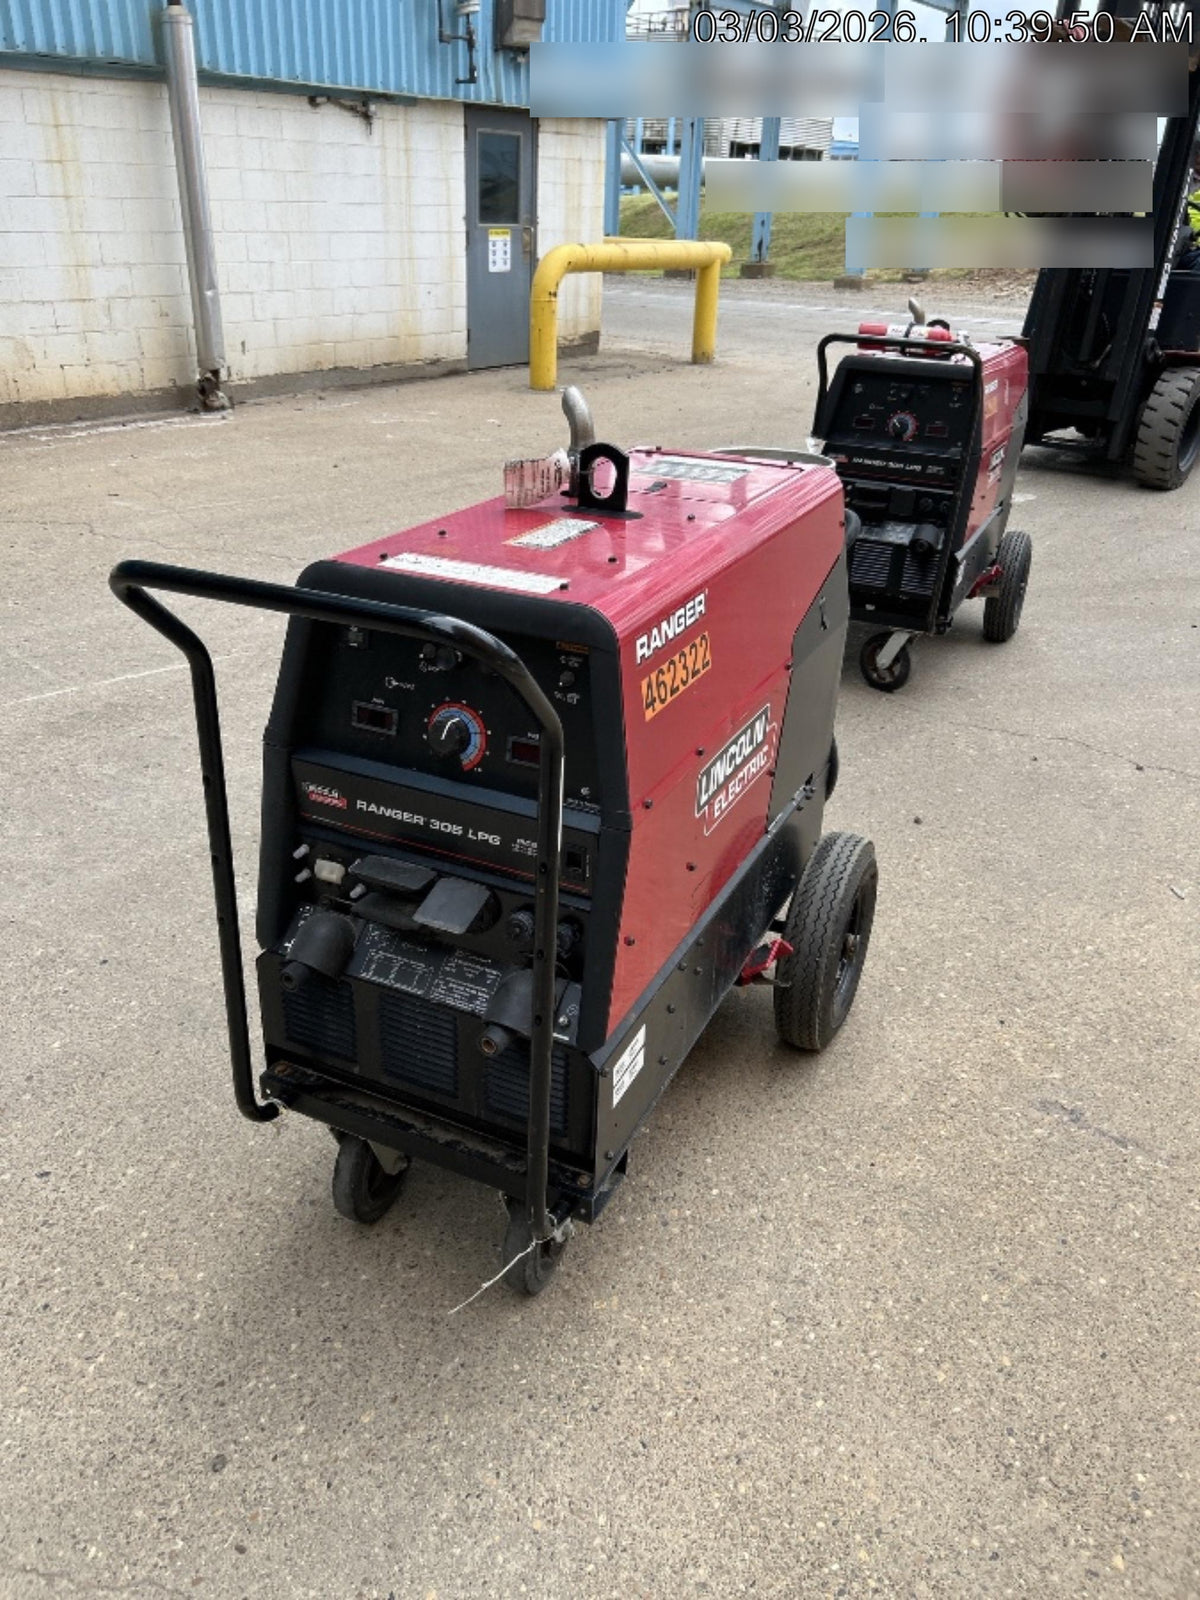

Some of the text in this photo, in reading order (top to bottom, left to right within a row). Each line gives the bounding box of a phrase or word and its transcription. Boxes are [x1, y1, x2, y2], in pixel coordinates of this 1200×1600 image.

[636, 594, 706, 663] RANGER
[644, 634, 711, 712] 462322
[700, 714, 766, 804] LINCOLN
[713, 746, 769, 818] ELECTRIC
[356, 800, 425, 826] RANGER
[429, 819, 463, 836] 305
[467, 828, 502, 845] LPG
